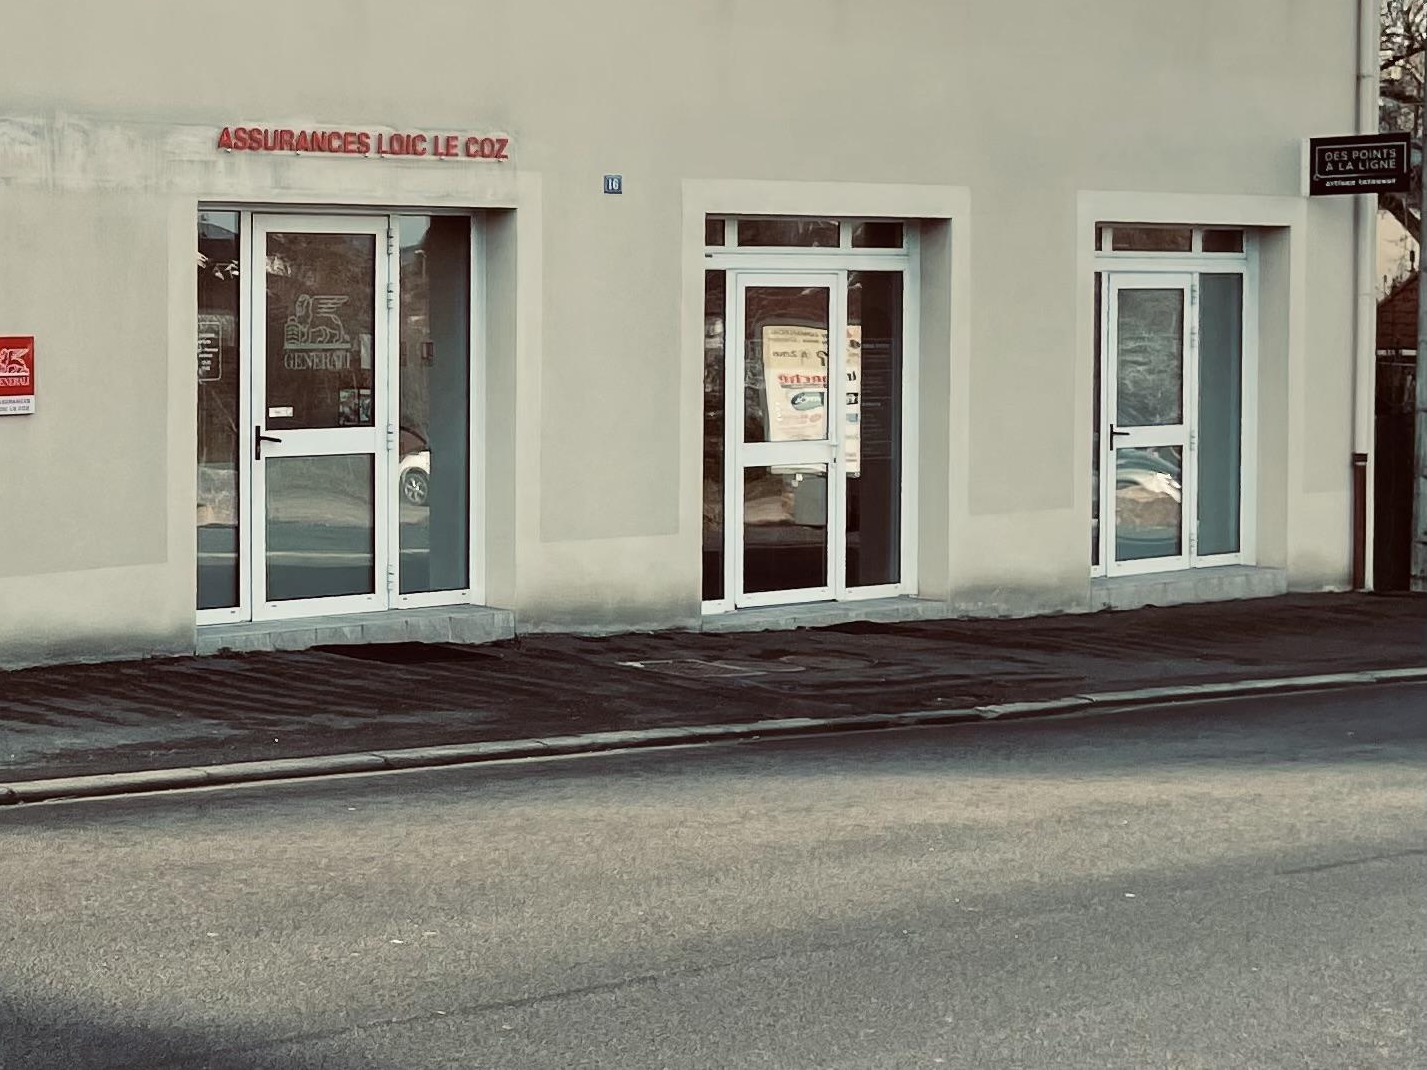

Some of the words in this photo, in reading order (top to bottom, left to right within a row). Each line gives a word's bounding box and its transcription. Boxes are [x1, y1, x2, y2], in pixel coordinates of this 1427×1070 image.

[217, 127, 371, 155] ASSURANCES
[377, 133, 427, 157] LOIC
[433, 135, 459, 157] LE
[465, 136, 509, 160] COZ
[1324, 150, 1348, 162] DES
[1352, 148, 1397, 160] POINTS
[1338, 161, 1354, 171] LA
[1358, 159, 1397, 170] LIGNE
[608, 178, 619, 190] 16
